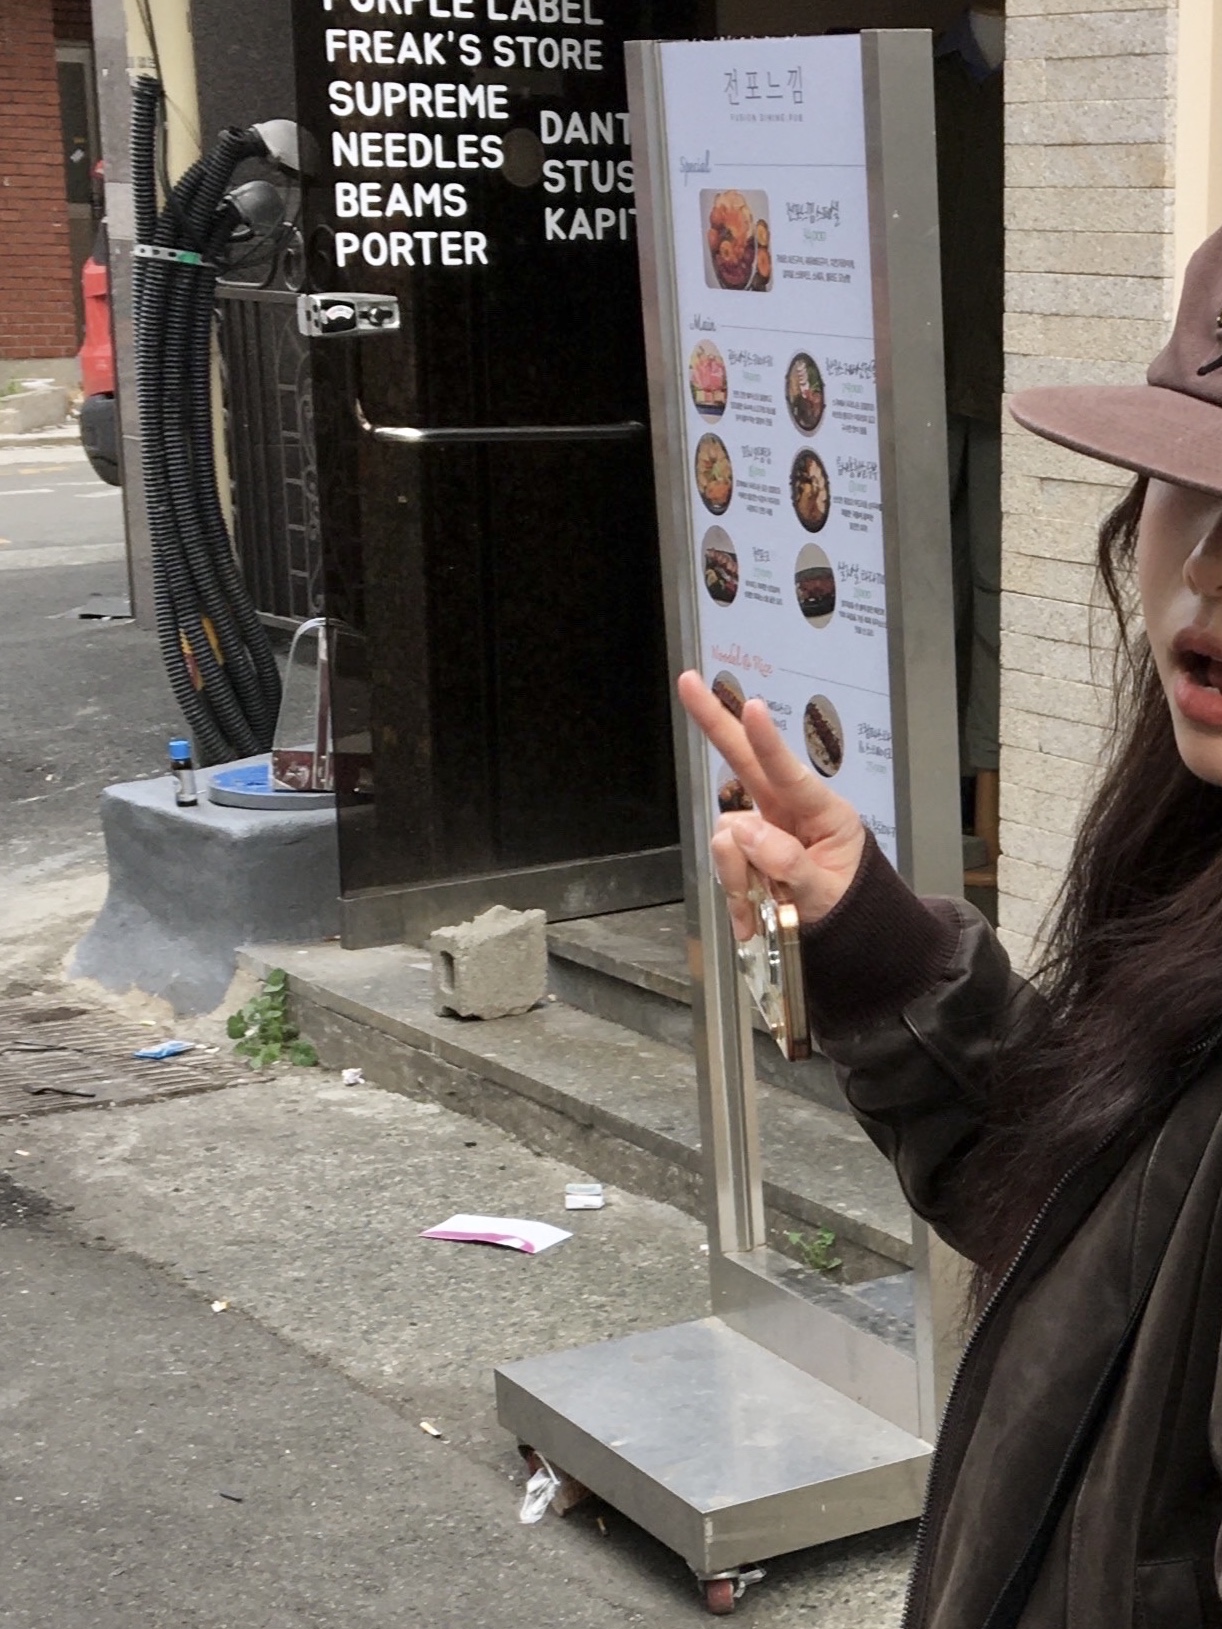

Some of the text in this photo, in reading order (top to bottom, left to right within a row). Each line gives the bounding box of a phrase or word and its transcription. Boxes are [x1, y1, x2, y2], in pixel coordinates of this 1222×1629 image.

[325, 28, 604, 70] FREAK'S STORE
[328, 81, 509, 119] SUPREME
[723, 66, 804, 105] 전포느낌
[332, 131, 505, 168] NEEDLES
[335, 182, 468, 218] BEAMS
[335, 231, 489, 267] PORTER
